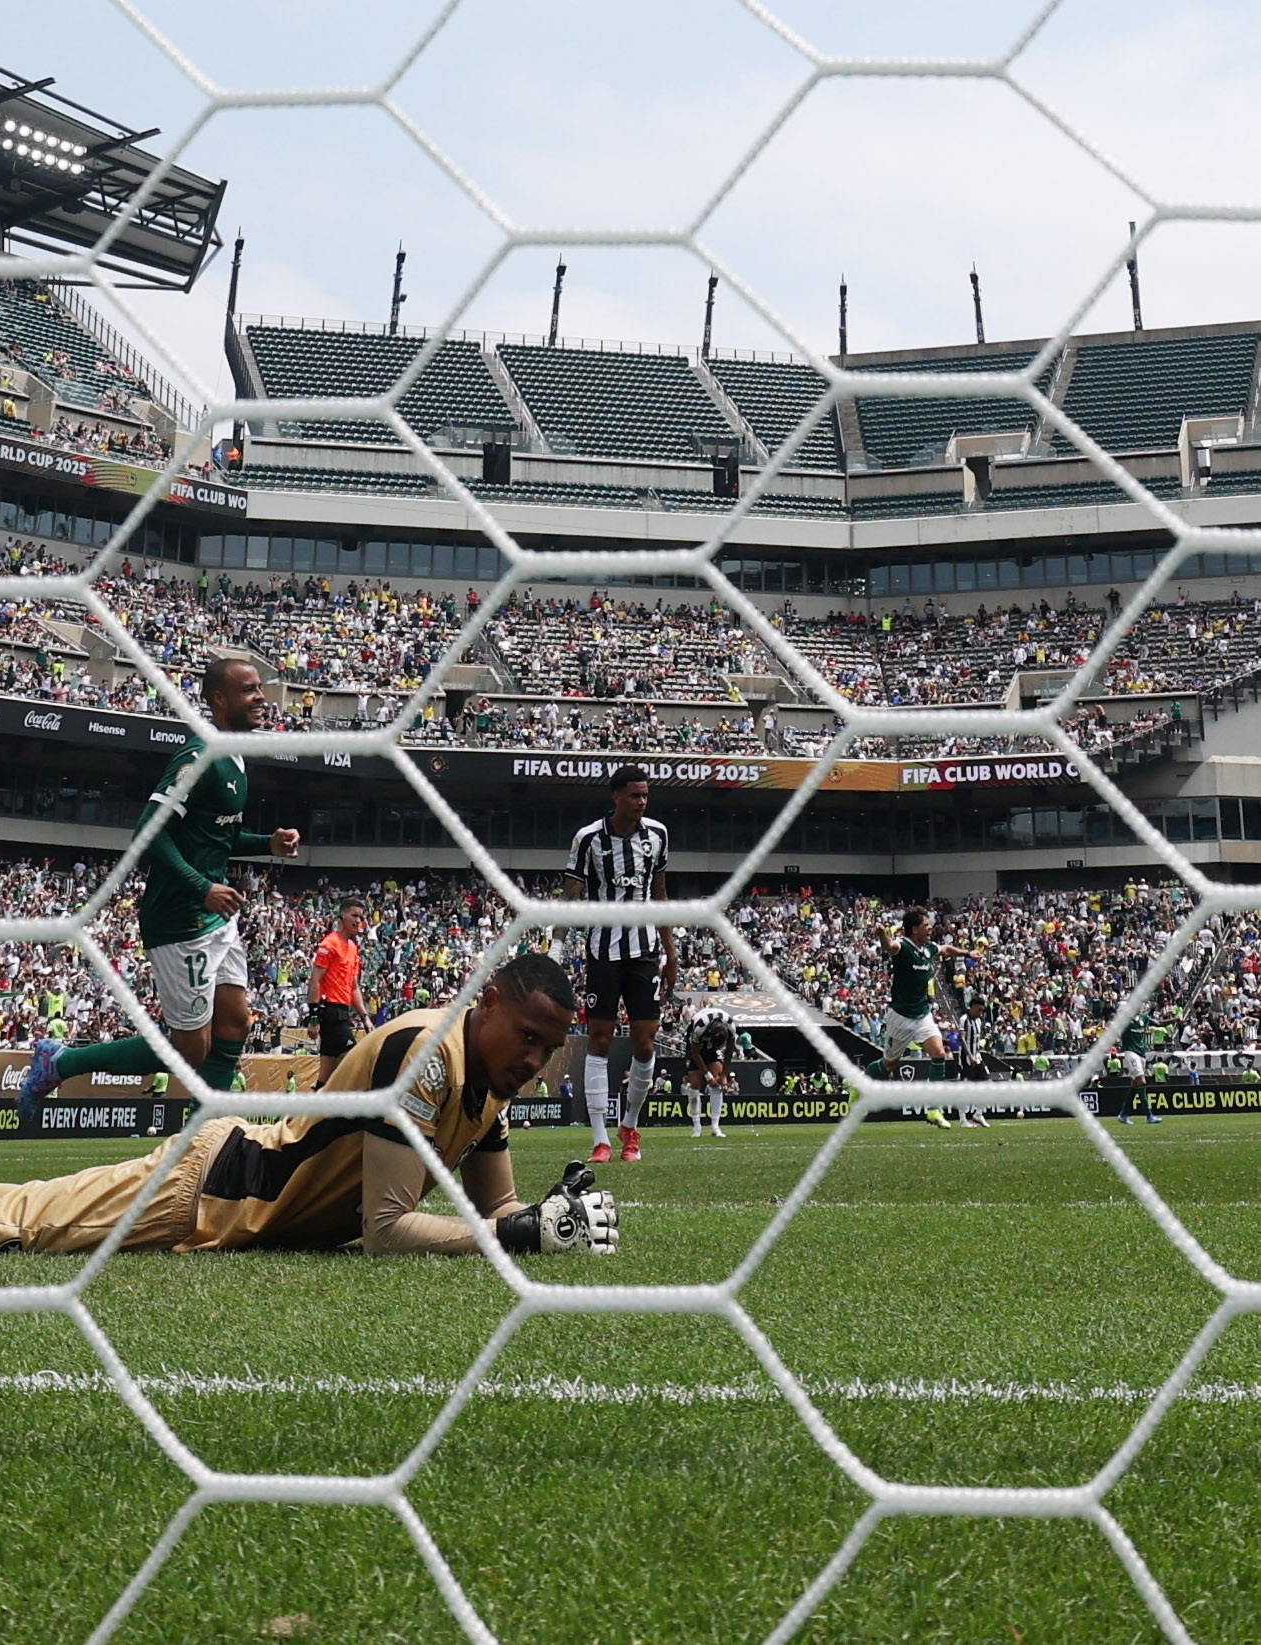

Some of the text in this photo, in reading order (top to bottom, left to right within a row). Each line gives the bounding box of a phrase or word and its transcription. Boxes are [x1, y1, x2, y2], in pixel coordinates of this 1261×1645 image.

[28, 451, 53, 468] CUP
[170, 482, 195, 499] FIFA
[197, 486, 226, 506] CLUB
[89, 722, 126, 736] Hisense
[150, 729, 186, 745] Lenovo
[323, 751, 351, 768] VISA
[513, 759, 551, 776] FIFA
[556, 761, 602, 778] CLUB
[608, 763, 672, 780] WLD
[676, 764, 711, 780] CUP
[903, 768, 942, 784] FIFA
[944, 765, 991, 782] CLUB
[995, 762, 1062, 780] WORLD
[611, 875, 644, 888] vbet
[185, 952, 208, 988] 12
[91, 1071, 142, 1085] Hisense
[961, 1103, 1005, 1114] AME
[1133, 1093, 1168, 1109] FFA
[1172, 1092, 1217, 1109] CLUB
[42, 1107, 136, 1129] EVERY GAME FREE
[511, 1104, 562, 1120] EVERY GAME FREE
[648, 1101, 683, 1118] FIFA
[732, 1102, 788, 1118] WORLD
[793, 1102, 827, 1117] CUP
